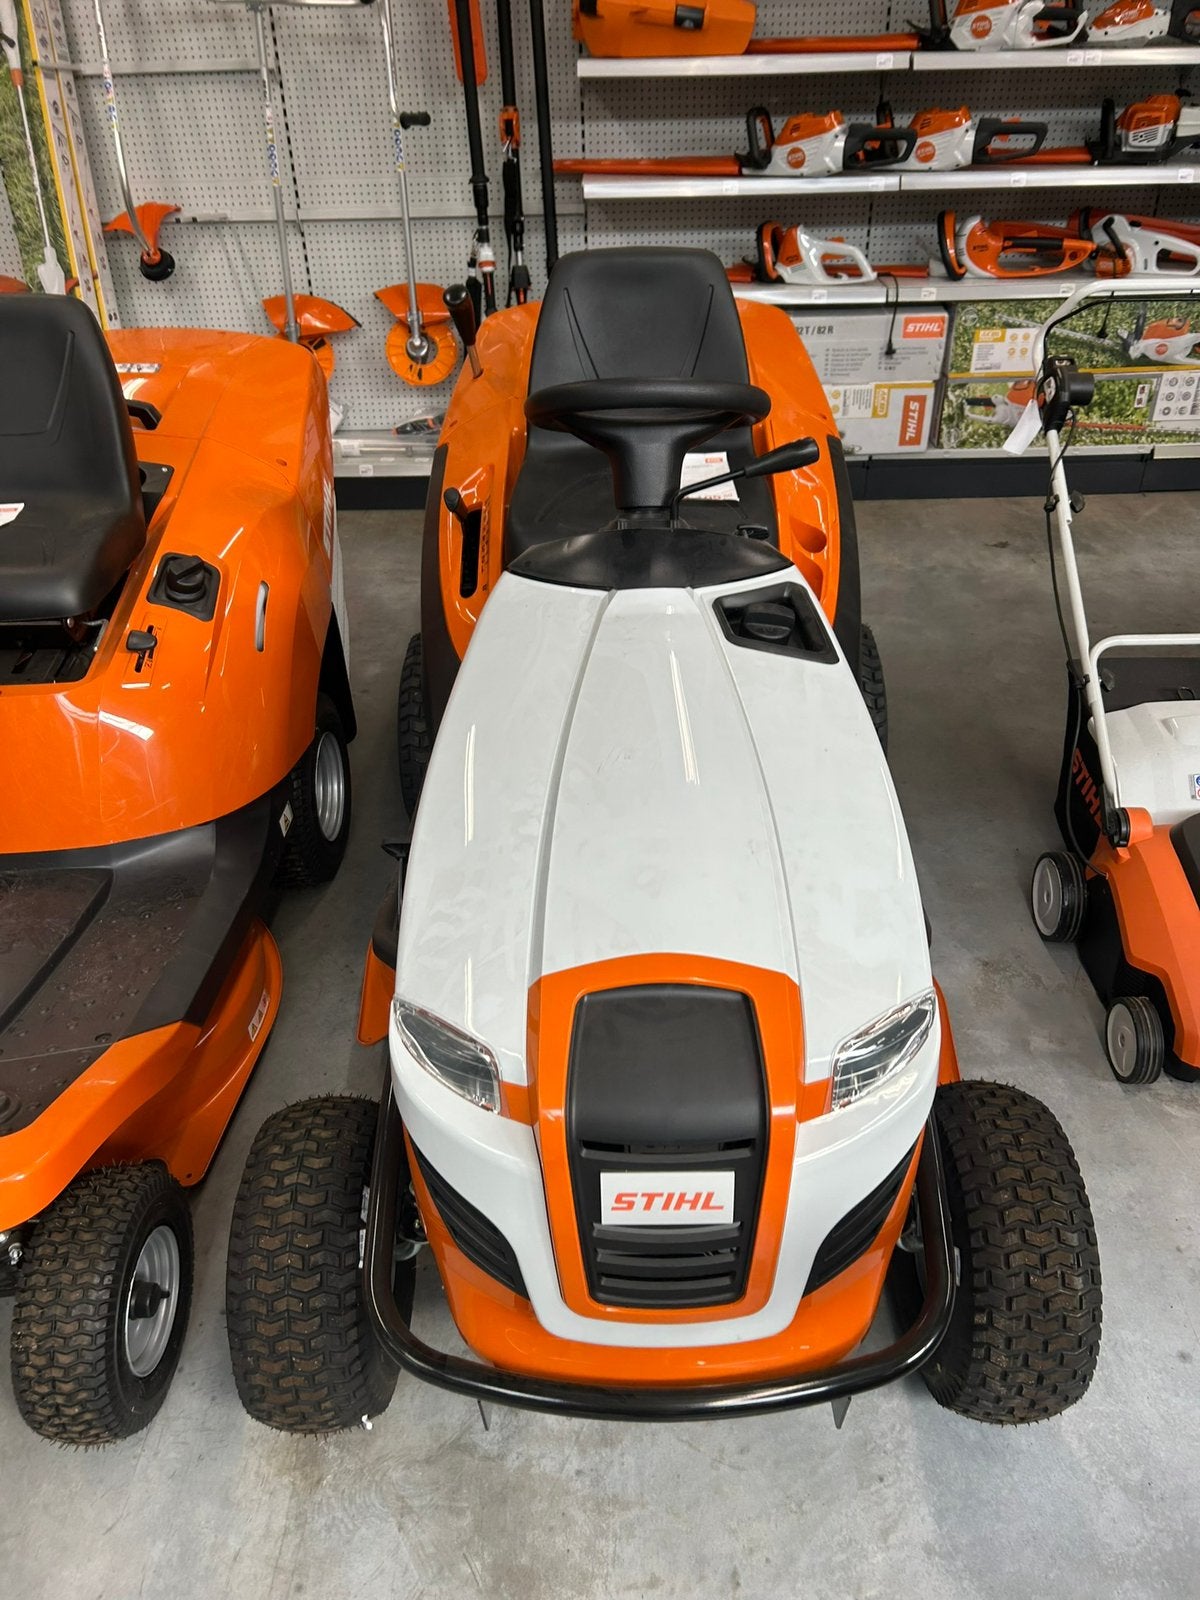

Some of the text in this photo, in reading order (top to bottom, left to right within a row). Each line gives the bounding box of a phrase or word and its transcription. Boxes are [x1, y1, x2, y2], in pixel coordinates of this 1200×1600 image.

[905, 322, 942, 333] STIHL
[904, 400, 920, 441] STIHL
[610, 1191, 724, 1212] STIHL
